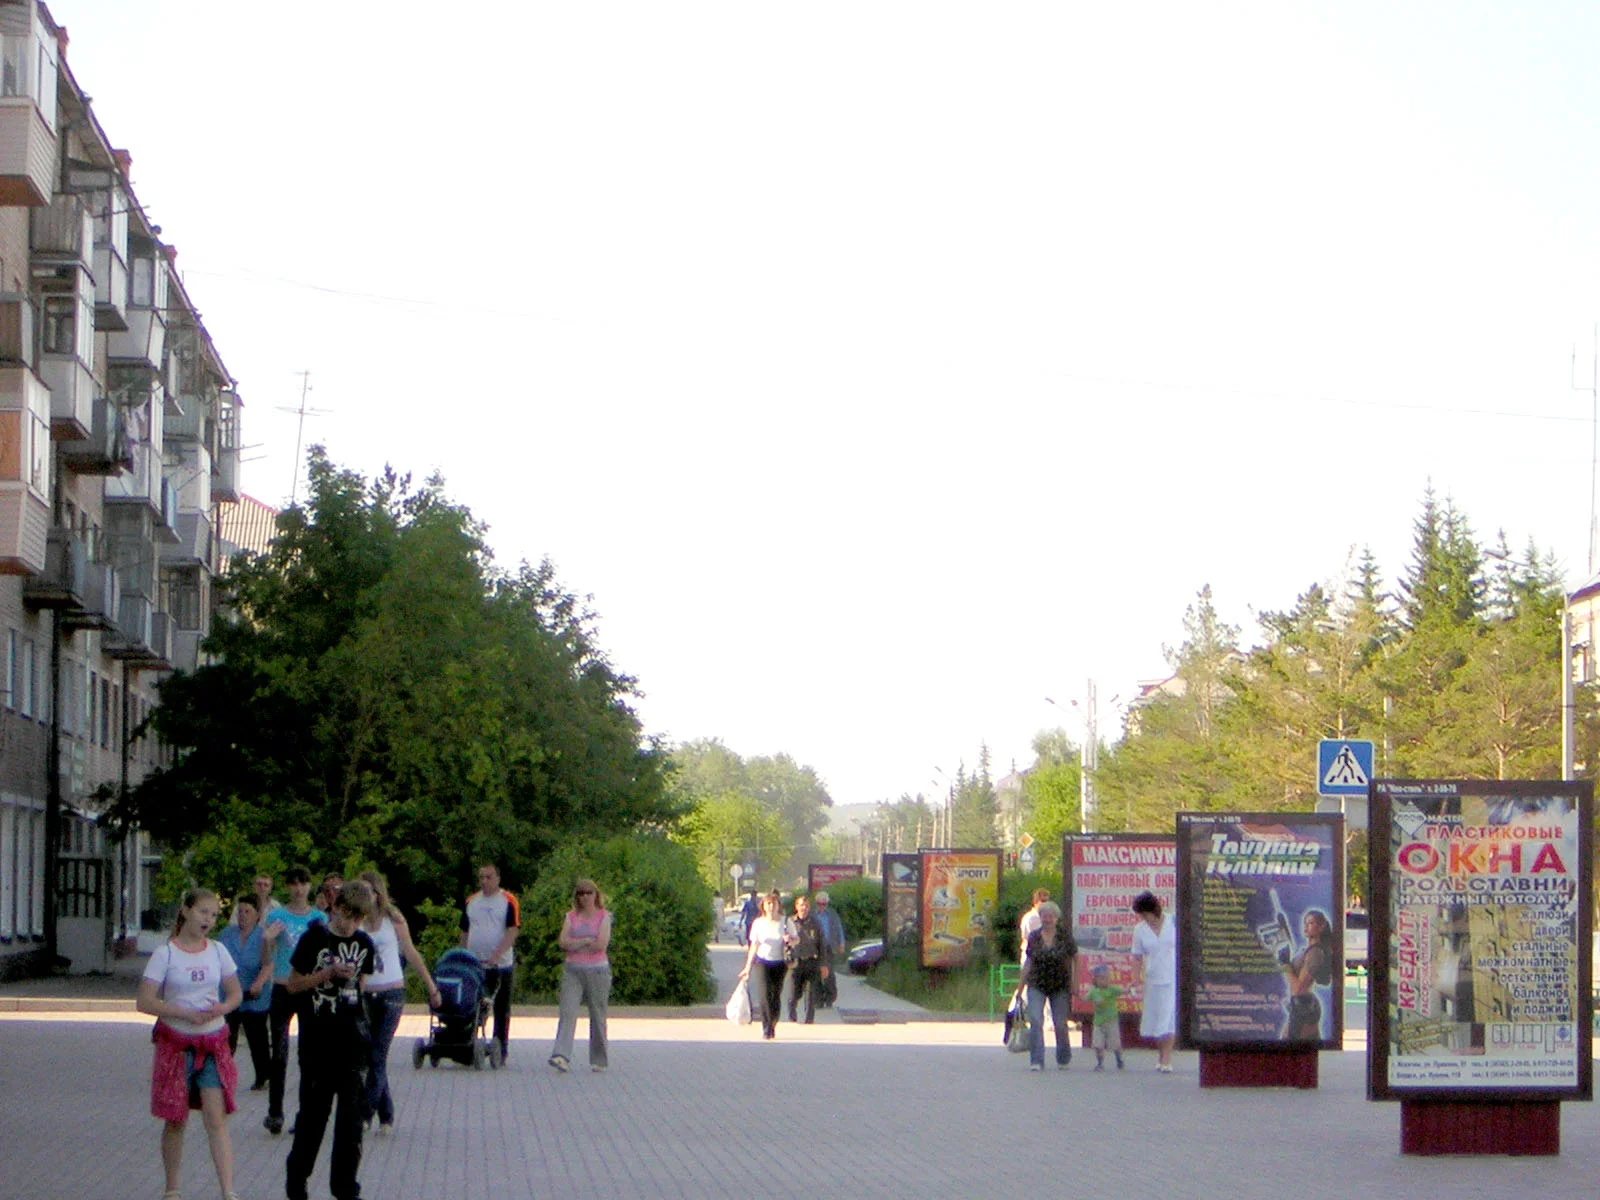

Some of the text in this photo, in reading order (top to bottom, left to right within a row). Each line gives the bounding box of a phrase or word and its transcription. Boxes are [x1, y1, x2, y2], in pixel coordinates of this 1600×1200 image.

[1426, 826, 1563, 840] ПЛАСТИКОВЫЕ
[1082, 845, 1177, 865] МАКСИМУМ
[1398, 842, 1567, 875] ОКНА
[1076, 873, 1176, 889] ПЛАСТИКОВЫЕ ОКН
[1401, 878, 1568, 892] РОЛЬСТАВНИ
[1086, 894, 1170, 908] ЕВРОБАЛЫ
[1400, 893, 1570, 905] НАТЯЖНЫЕ ПОТОЛКИ
[1521, 911, 1569, 920] жалюзи
[1534, 926, 1569, 937] двери
[1512, 942, 1569, 951] стальные
[1399, 910, 1417, 1010] КРЕДИТ!
[1478, 958, 1569, 967] межкомнатные
[191, 969, 205, 982] 83
[1500, 973, 1569, 982] остекление
[1513, 986, 1569, 998] балконов
[1513, 1005, 1520, 1014] и
